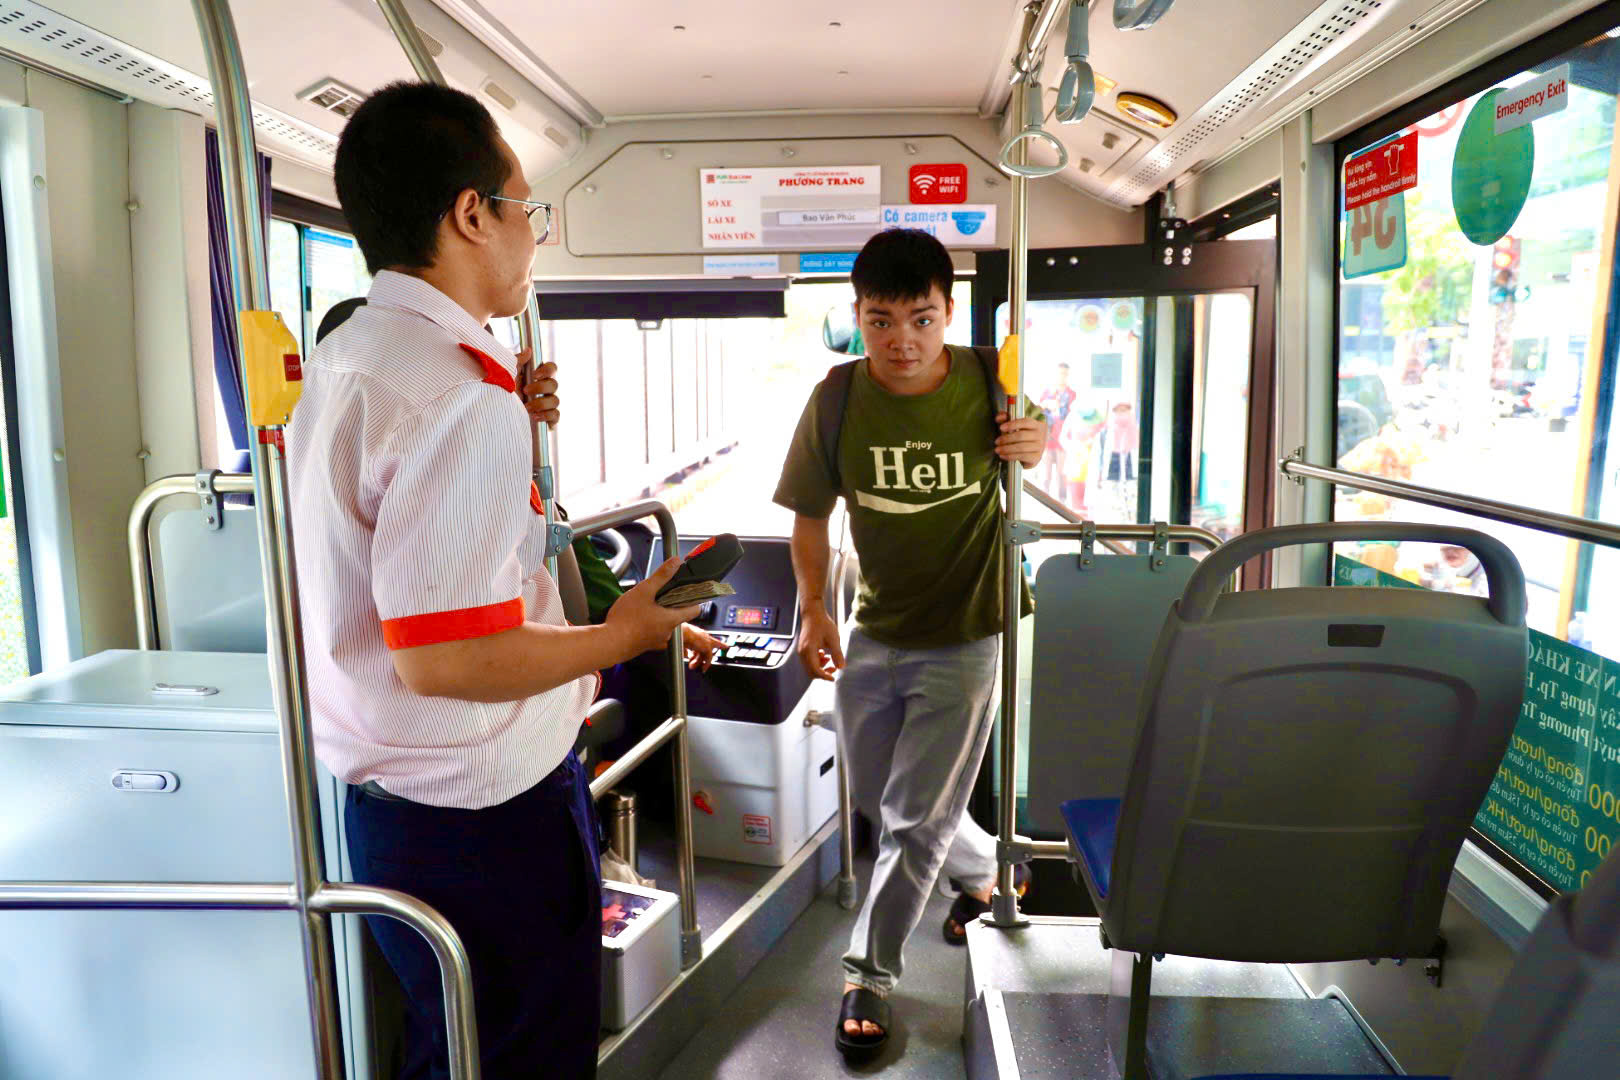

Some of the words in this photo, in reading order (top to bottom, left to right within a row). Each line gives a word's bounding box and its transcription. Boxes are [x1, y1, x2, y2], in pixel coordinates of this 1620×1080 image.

[1497, 90, 1545, 119] Emergency
[1547, 80, 1565, 99] Exit
[779, 177, 824, 187] PHƯƠNG
[827, 176, 865, 186] TRANG
[939, 176, 961, 184] FREE
[1361, 190, 1372, 200] hold
[1372, 187, 1380, 196] the
[721, 199, 732, 208] XE
[725, 216, 736, 225] XE
[884, 208, 899, 223] Có
[904, 211, 948, 223] camera
[707, 231, 733, 241] NHÂN
[735, 230, 756, 241] VIÊN
[905, 440, 932, 450] Enjoy
[869, 446, 967, 490] Hell
